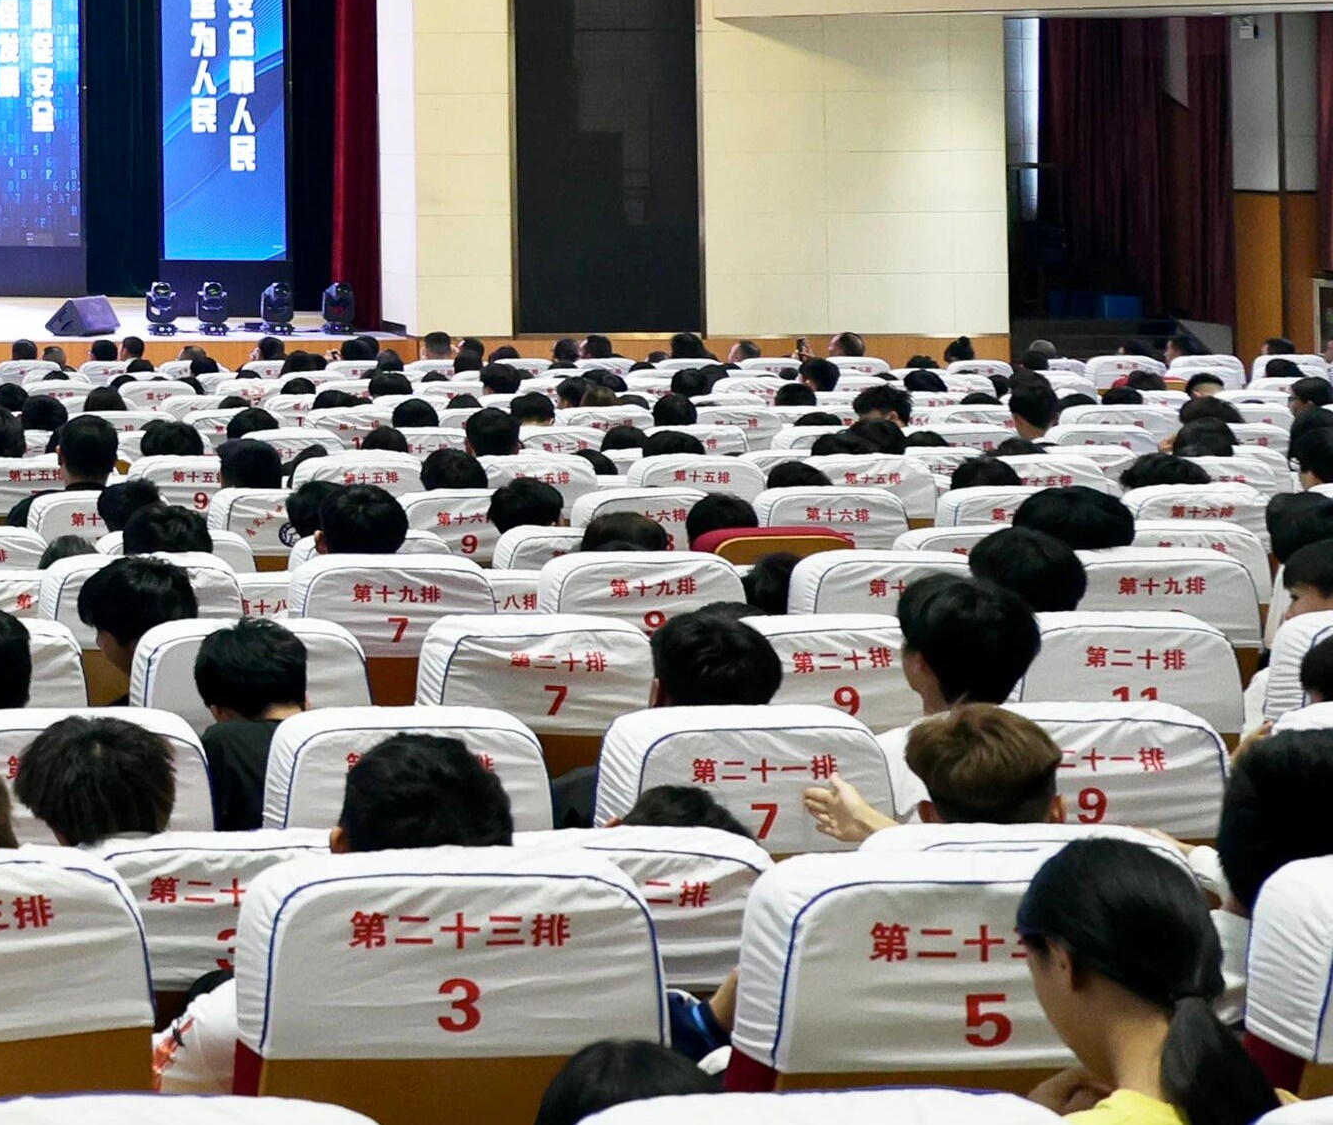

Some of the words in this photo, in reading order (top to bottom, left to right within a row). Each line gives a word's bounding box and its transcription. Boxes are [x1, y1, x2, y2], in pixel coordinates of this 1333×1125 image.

[172, 471, 223, 484] 第十五
[343, 471, 399, 485] 第十五排
[673, 470, 730, 484] 第十五排
[844, 471, 901, 485] 第十五排
[193, 491, 209, 511] 9
[1171, 505, 1237, 518] 第十六排
[72, 512, 100, 527] 第十
[437, 511, 487, 527] 第十六
[644, 507, 689, 523] 十六排
[806, 507, 869, 524] 第十六排
[461, 533, 481, 555] 9
[353, 583, 443, 603] 第十九排
[610, 577, 698, 599] 第十九排
[870, 578, 905, 596] 第十
[1118, 576, 1205, 596] 第十九排
[504, 593, 538, 610] 八排
[388, 616, 410, 644] 7
[508, 651, 608, 676] 第二十排
[791, 646, 893, 675] 第二十排
[1086, 646, 1186, 670] 第二十排
[543, 683, 570, 716] 7
[832, 686, 861, 716] 9
[693, 754, 840, 786] 第二十一排
[1059, 747, 1166, 773] 二十一排
[1077, 786, 1109, 824] 9
[751, 802, 779, 839] 7
[149, 876, 245, 907] 第二十
[349, 910, 571, 950] 第二十三排
[869, 922, 1032, 963] 第二十
[438, 977, 481, 1033] 3
[965, 992, 1013, 1048] 5
